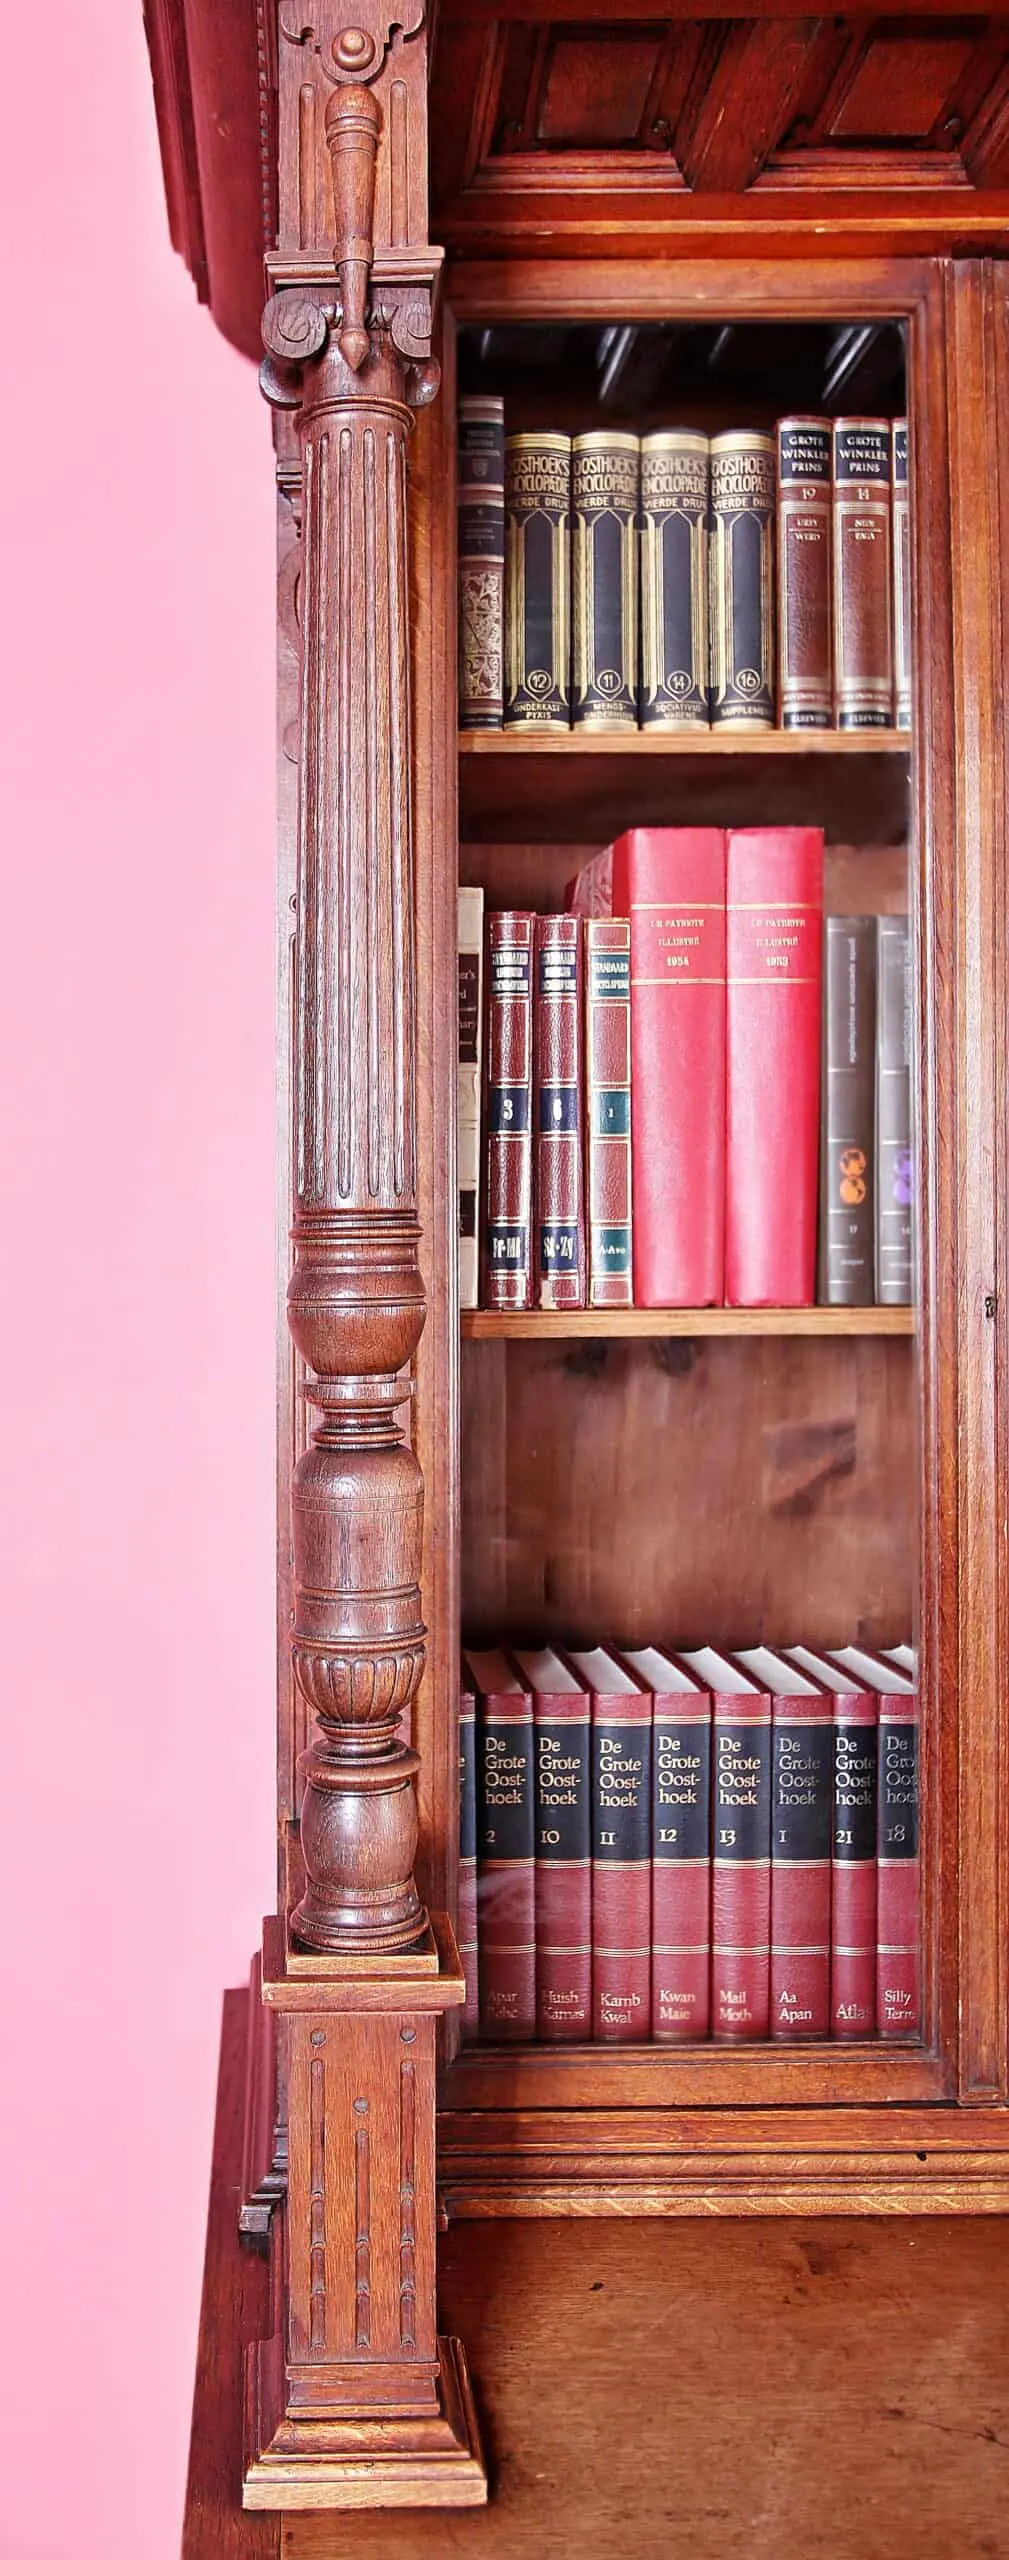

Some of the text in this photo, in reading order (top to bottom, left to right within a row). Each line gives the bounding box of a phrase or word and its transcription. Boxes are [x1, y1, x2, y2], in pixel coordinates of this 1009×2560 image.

[788, 435, 825, 446] GROTE
[847, 436, 881, 447] GROTE
[839, 449, 889, 461] WINKLER
[792, 462, 822, 472] PRINS
[849, 463, 880, 473] PRINS
[801, 487, 816, 500] 19
[642, 497, 679, 509] VIERDE
[711, 497, 748, 510] VIERDE
[531, 674, 547, 689] 12
[602, 674, 614, 689] 11
[672, 676, 685, 690] 14
[741, 673, 756, 688] 16
[503, 1099, 513, 1121] 3
[485, 1737, 506, 1751] De
[539, 1738, 560, 1752] De
[600, 1739, 622, 1753] De
[658, 1736, 680, 1751] De
[719, 1737, 742, 1752] De
[779, 1738, 801, 1752] De
[836, 1737, 858, 1752] De
[887, 1736, 908, 1750] De
[485, 1755, 526, 1769] Grote
[539, 1755, 581, 1770] Grote
[600, 1757, 641, 1771] Grote
[658, 1754, 700, 1769] Grote
[719, 1755, 761, 1770] Grote
[779, 1756, 820, 1770] Grote
[886, 1753, 915, 1768] Gro
[485, 1772, 526, 1787] Oost-
[539, 1772, 581, 1787] Oost-
[600, 1774, 641, 1788] Oost-
[658, 1771, 701, 1786] Oost-
[719, 1773, 761, 1788] Oost-
[779, 1773, 820, 1788] Oost-
[486, 1789, 523, 1804] hoek
[540, 1790, 578, 1805] hoek
[600, 1791, 638, 1807] hoek
[658, 1789, 697, 1804] hoek
[719, 1790, 758, 1805] hoek
[779, 1790, 816, 1805] hoek
[836, 1790, 872, 1805] hoek
[486, 1830, 496, 1843] 2
[541, 1830, 560, 1844] 10
[658, 1829, 677, 1842] 12
[719, 1830, 737, 1847] 13
[779, 1830, 787, 1843] 1
[835, 1830, 854, 1844] 21
[886, 1824, 905, 1842] 18
[600, 1993, 640, 2007] Kamb
[660, 1990, 696, 2003] Kwan
[720, 1990, 746, 2004] Mail
[779, 1990, 797, 2003] Aa
[885, 1990, 911, 2006] Silly
[601, 2009, 632, 2024] Kwal
[720, 2008, 752, 2022] Moth
[779, 2008, 812, 2024] Apan
